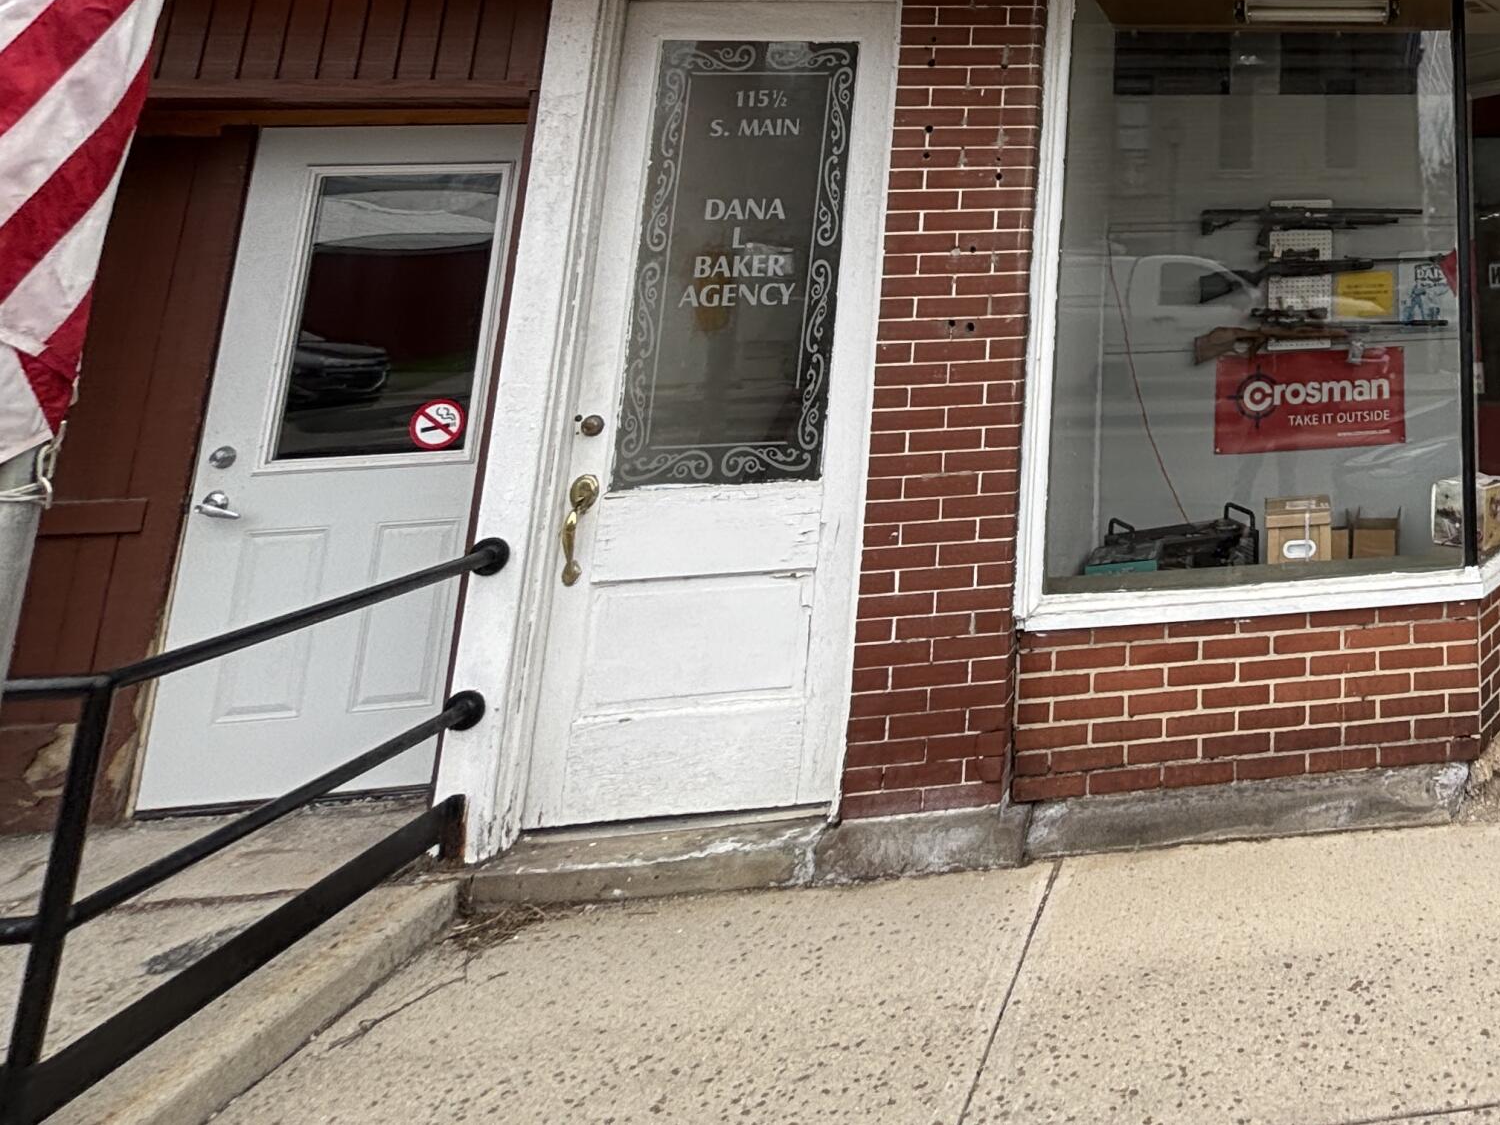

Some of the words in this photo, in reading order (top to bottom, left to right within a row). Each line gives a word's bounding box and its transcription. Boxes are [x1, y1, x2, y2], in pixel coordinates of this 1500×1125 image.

[710, 119, 730, 137] S.
[738, 118, 800, 137] MAIN
[704, 198, 786, 221] DANA
[732, 228, 753, 250] L.
[693, 255, 786, 279] BAKER
[679, 282, 796, 308] AGENCY
[1243, 378, 1391, 412] Crosman
[1288, 413, 1318, 426] TAKE
[1322, 412, 1333, 425] IT
[1336, 410, 1391, 423] OUTSIDE
